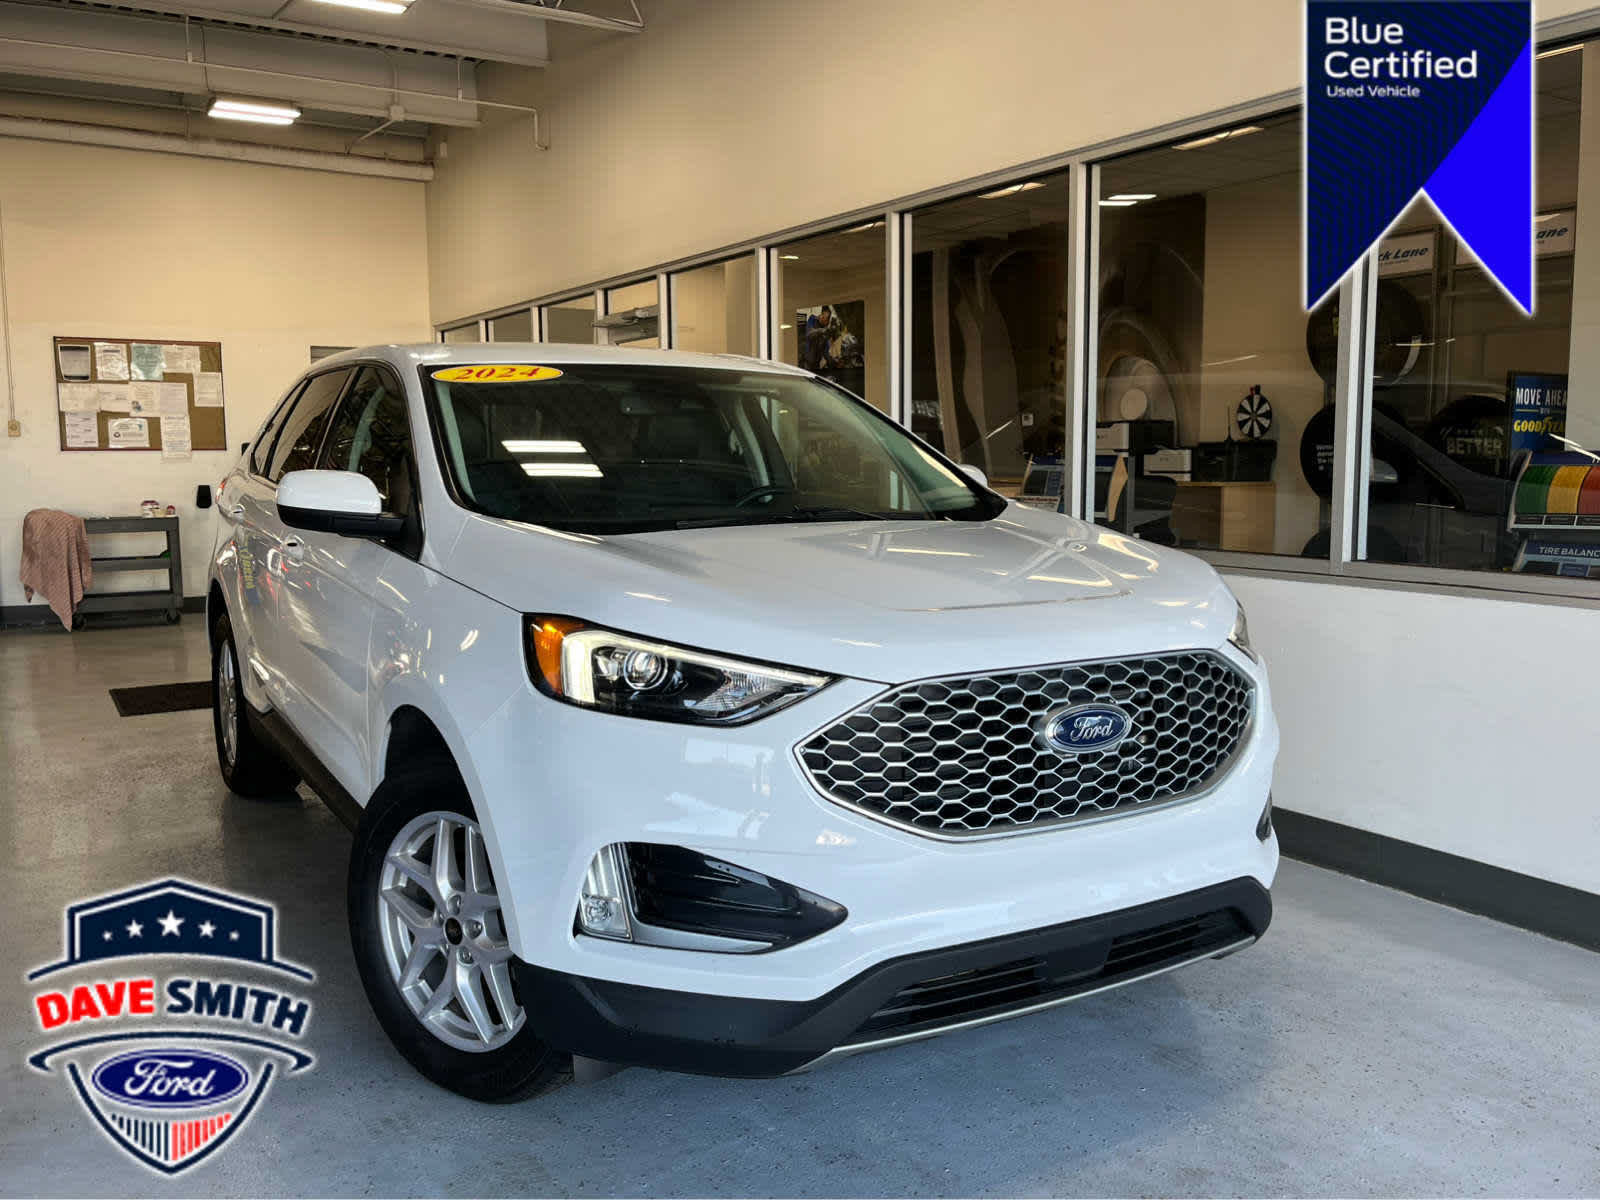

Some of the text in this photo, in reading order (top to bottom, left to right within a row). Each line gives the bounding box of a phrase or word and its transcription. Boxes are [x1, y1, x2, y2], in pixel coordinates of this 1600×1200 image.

[1393, 247, 1428, 259] Lane
[454, 367, 540, 380] 2024
[1515, 387, 1542, 406] MOVE
[1446, 437, 1502, 456] BETTER
[1539, 546, 1560, 555] TIRE
[1070, 716, 1113, 742] Ford
